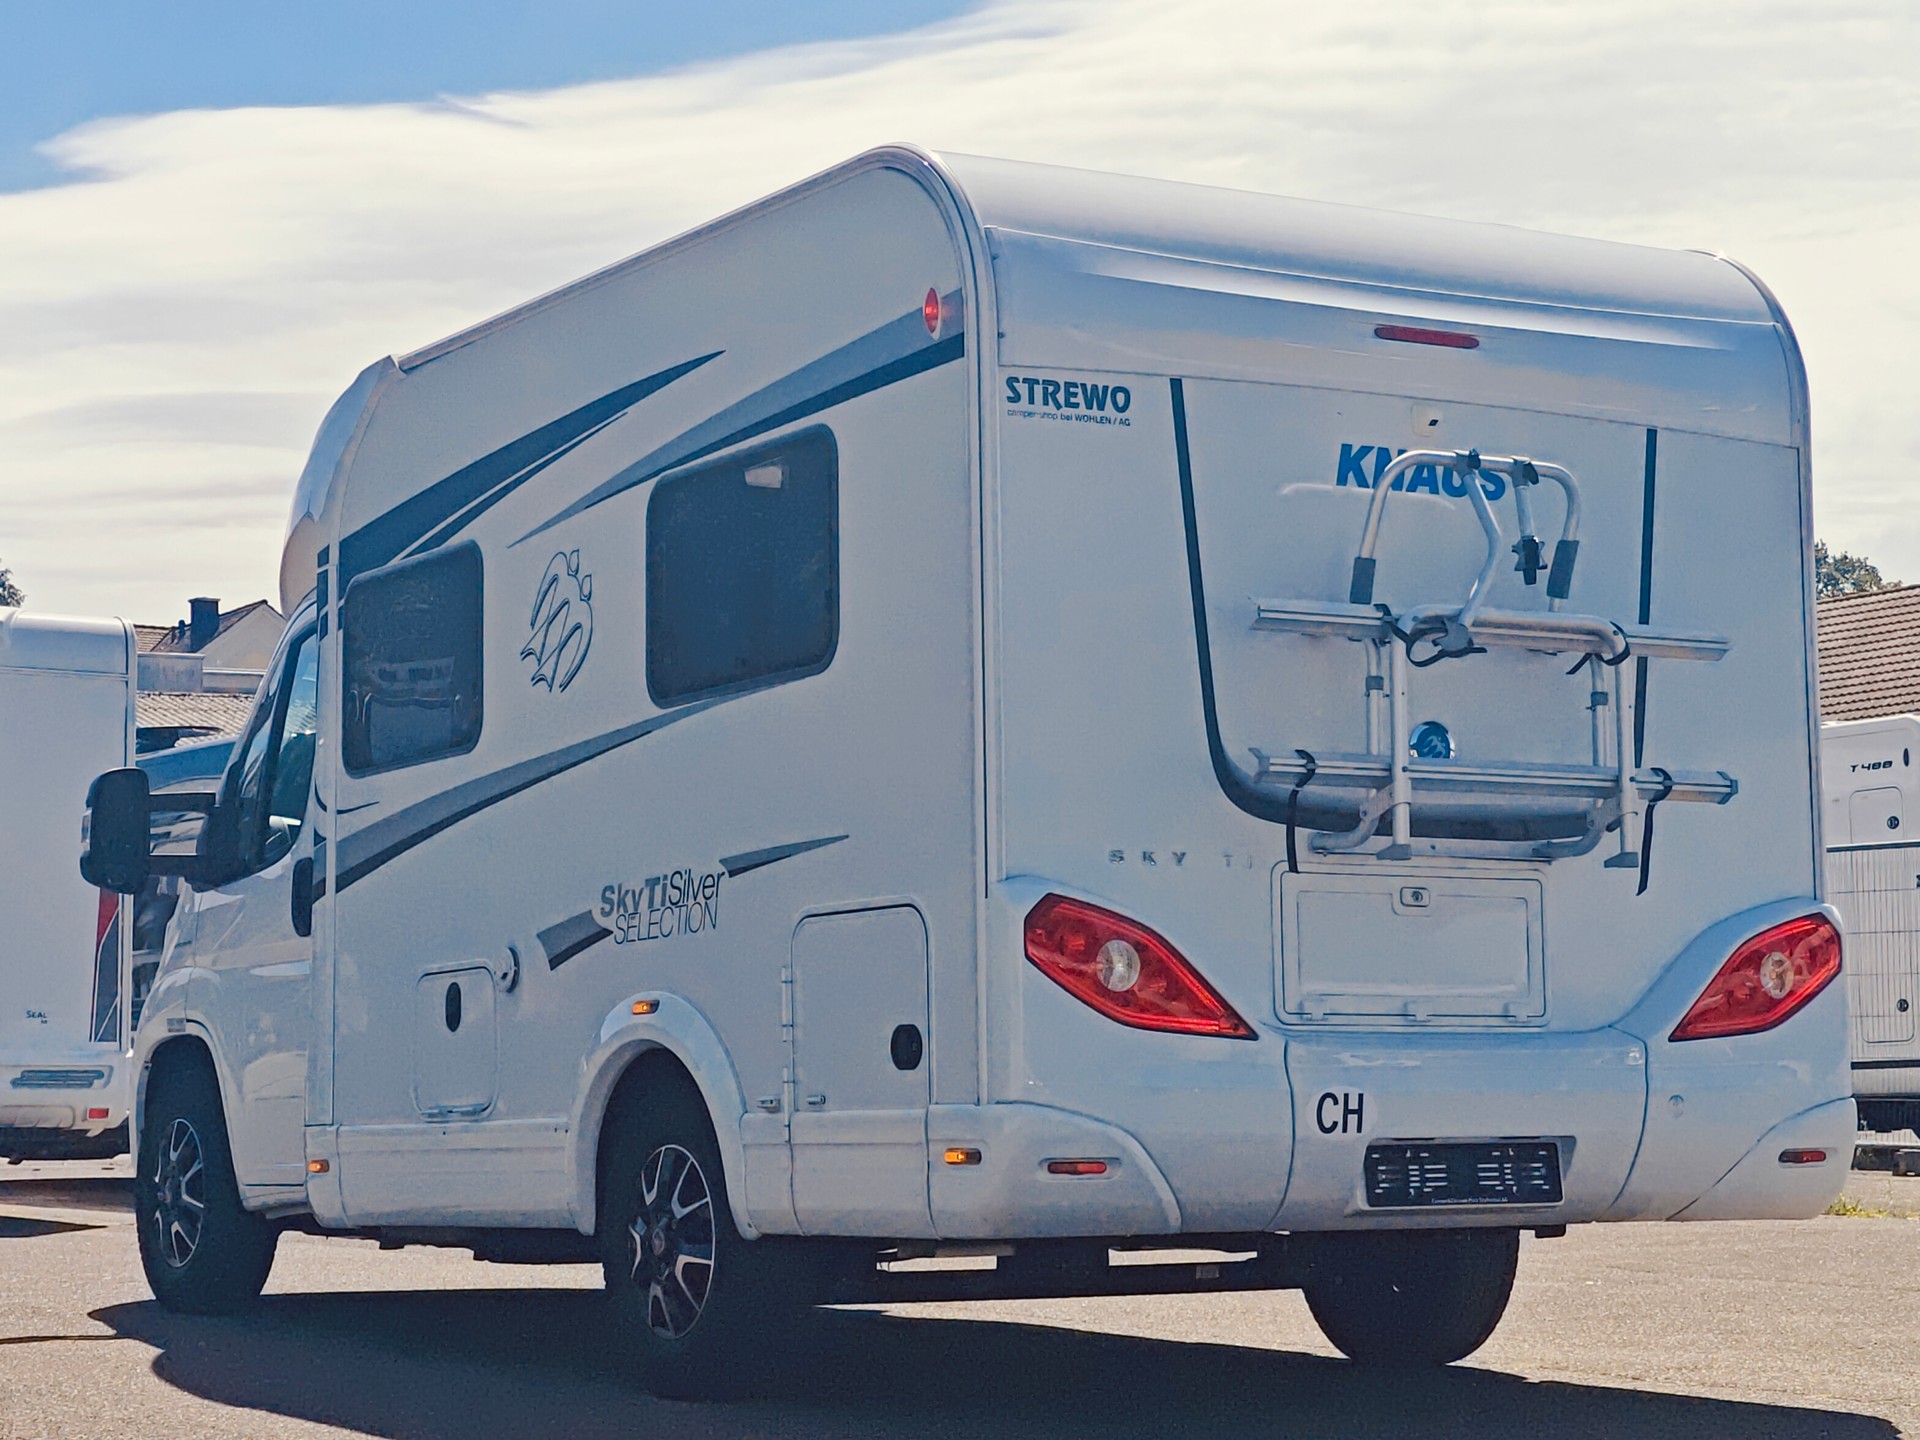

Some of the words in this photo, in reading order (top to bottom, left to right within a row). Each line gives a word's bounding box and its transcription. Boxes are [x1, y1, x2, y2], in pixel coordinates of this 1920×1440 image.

[1005, 376, 1131, 413] STREWO
[1075, 414, 1112, 425] WOHLEN
[1119, 418, 1131, 426] AG
[1850, 764, 1859, 773] T
[1108, 849, 1187, 867] SKY
[614, 901, 719, 945] SELECTION
[1316, 1092, 1364, 1134] CH
